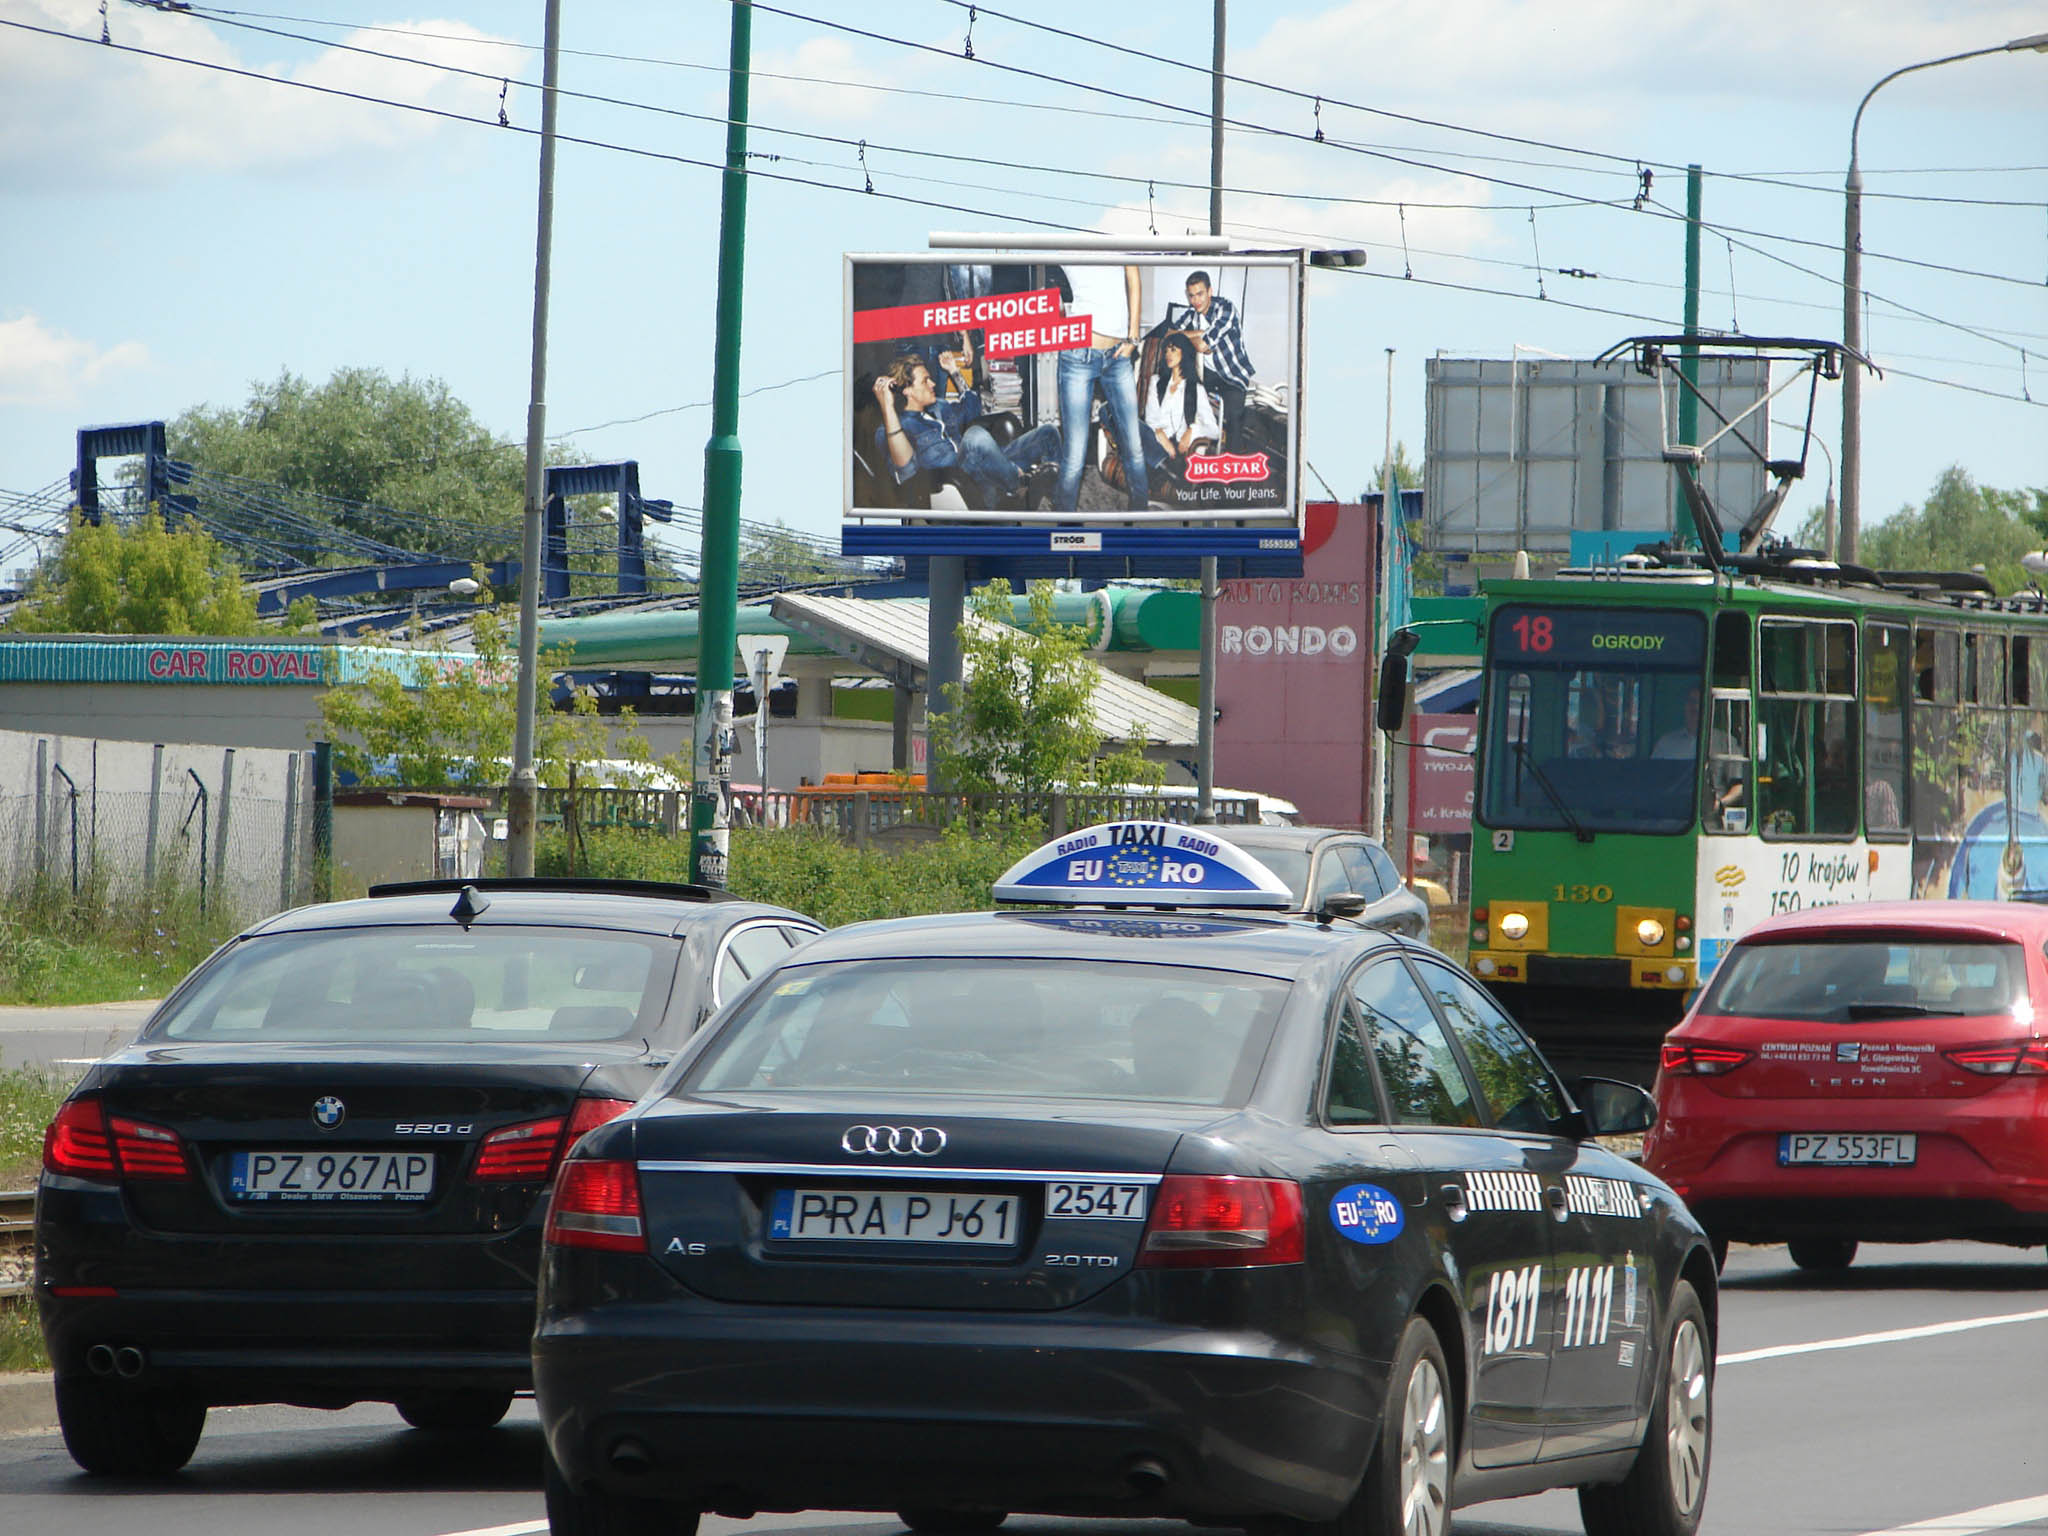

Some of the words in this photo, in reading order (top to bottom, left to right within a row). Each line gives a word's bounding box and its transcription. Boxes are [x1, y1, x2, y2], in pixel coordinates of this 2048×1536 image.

[923, 305, 971, 328] FREE
[974, 295, 1054, 321] CHOICE.
[989, 329, 1036, 352] FREE
[1040, 323, 1087, 345] LIFE!
[1193, 462, 1219, 475] BIG
[1223, 462, 1260, 474] STAR
[1175, 488, 1198, 501] Your
[1200, 487, 1221, 500] Life.
[1224, 487, 1246, 499] Your
[1248, 487, 1278, 501] Jeans.
[1222, 583, 1282, 604] AUTO
[1292, 583, 1360, 605] KOMIS
[1221, 625, 1357, 656] RONDO
[1512, 615, 1554, 652] 18
[1592, 634, 1665, 650] OGRODY
[149, 650, 206, 678] CAR
[227, 651, 318, 680] ROYAL
[1057, 835, 1098, 856] RADIO
[1108, 825, 1167, 847] TAXI
[1177, 835, 1220, 857] RADIO
[1498, 833, 1508, 848] 2
[1067, 860, 1104, 881] EU
[1160, 862, 1205, 884] RO
[1782, 852, 1800, 883] 10
[1808, 852, 1860, 892] krajów
[1553, 884, 1614, 904] 130
[1771, 891, 1801, 916] 150
[1810, 1078, 1886, 1086] LEON
[395, 1123, 451, 1134] 520
[1794, 1136, 1828, 1159] PZ
[1837, 1136, 1910, 1160] 553FL
[233, 1178, 245, 1187] PL
[252, 1155, 303, 1189] PZ
[316, 1155, 427, 1190] 967AP
[312, 1192, 334, 1200] BMW
[1053, 1184, 1140, 1216] 2547
[774, 1220, 789, 1231] PL
[798, 1194, 886, 1235] PRA
[905, 1196, 1009, 1240] PJ61
[1336, 1202, 1358, 1227] EU
[1377, 1200, 1398, 1225] RO
[1082, 1255, 1118, 1268] TDI
